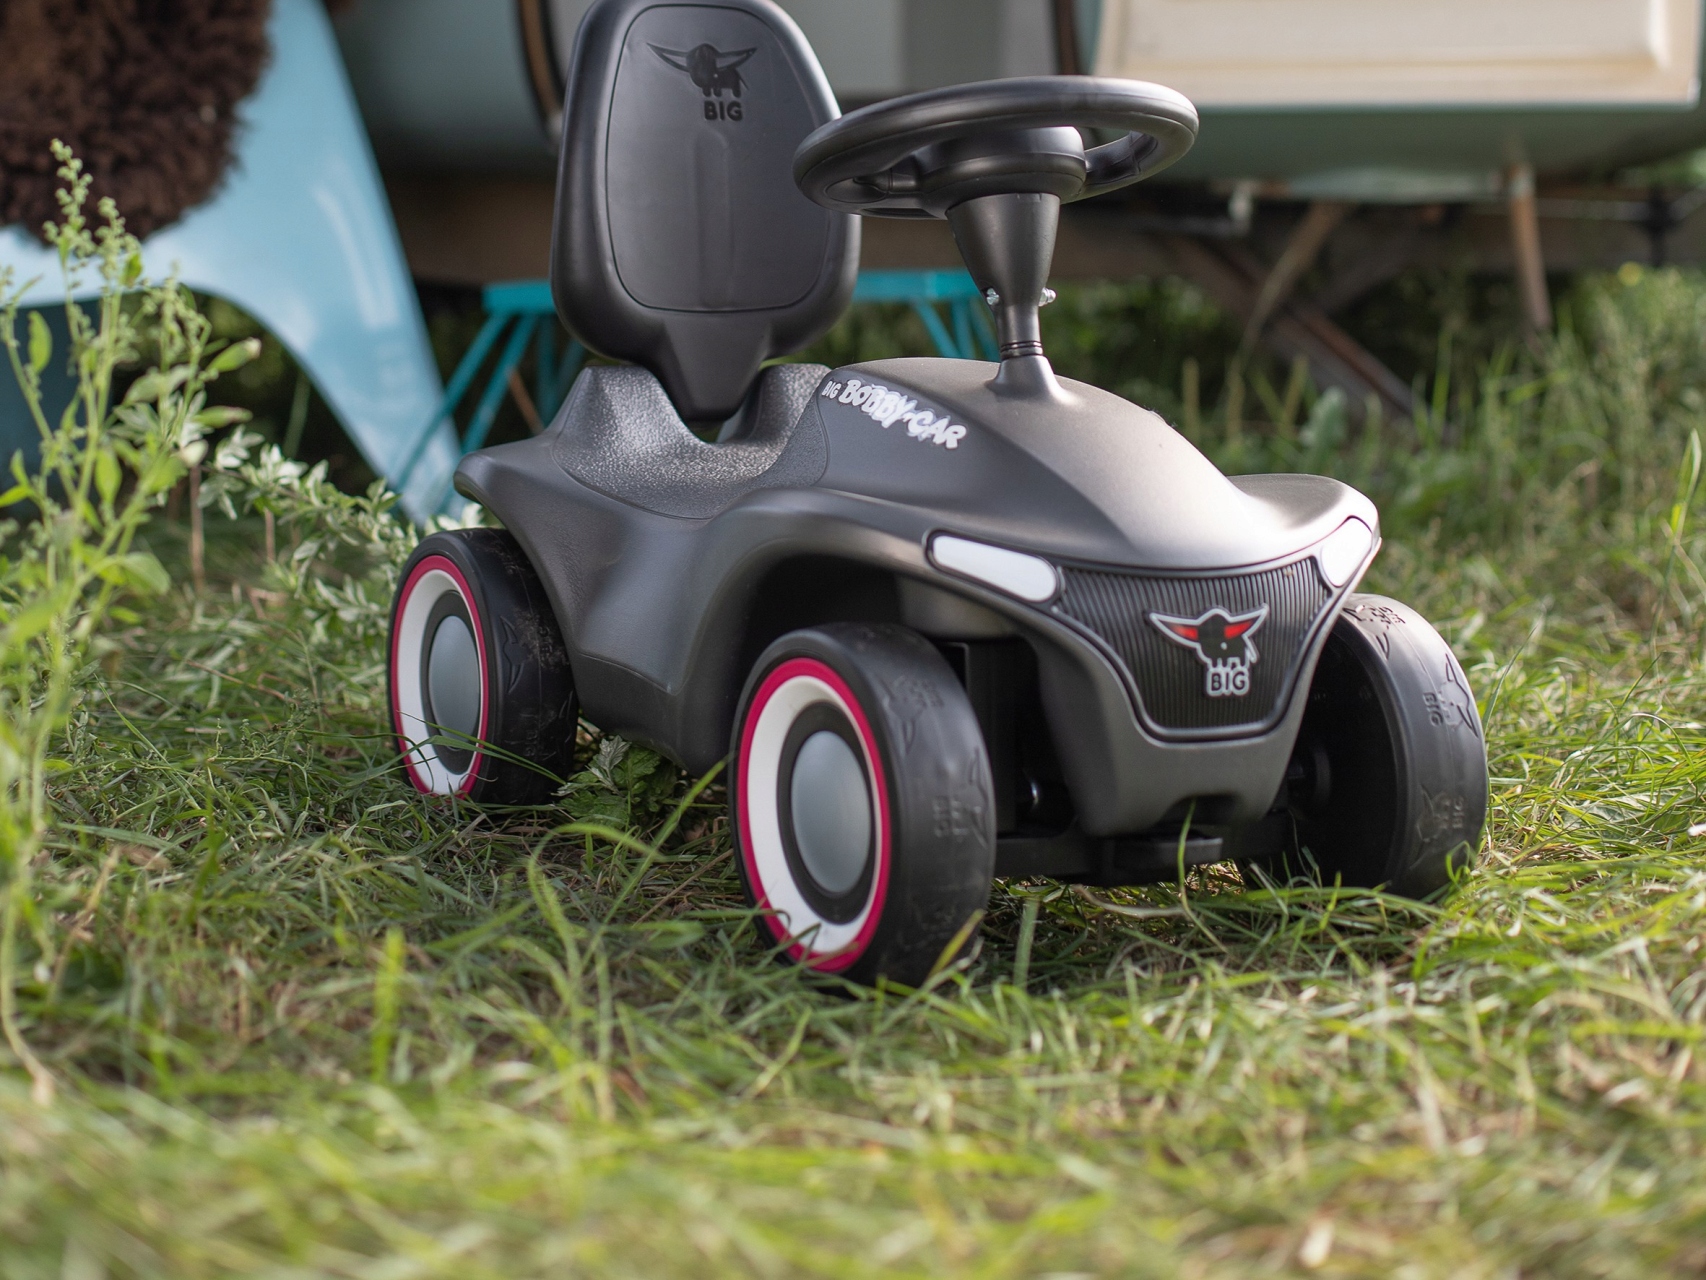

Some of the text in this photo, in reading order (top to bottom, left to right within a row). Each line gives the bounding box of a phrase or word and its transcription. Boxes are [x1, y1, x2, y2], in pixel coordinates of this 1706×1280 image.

[704, 100, 743, 121] BIG
[822, 380, 842, 399] BIG
[1208, 670, 1247, 693] BIG
[1422, 692, 1444, 727] BIG
